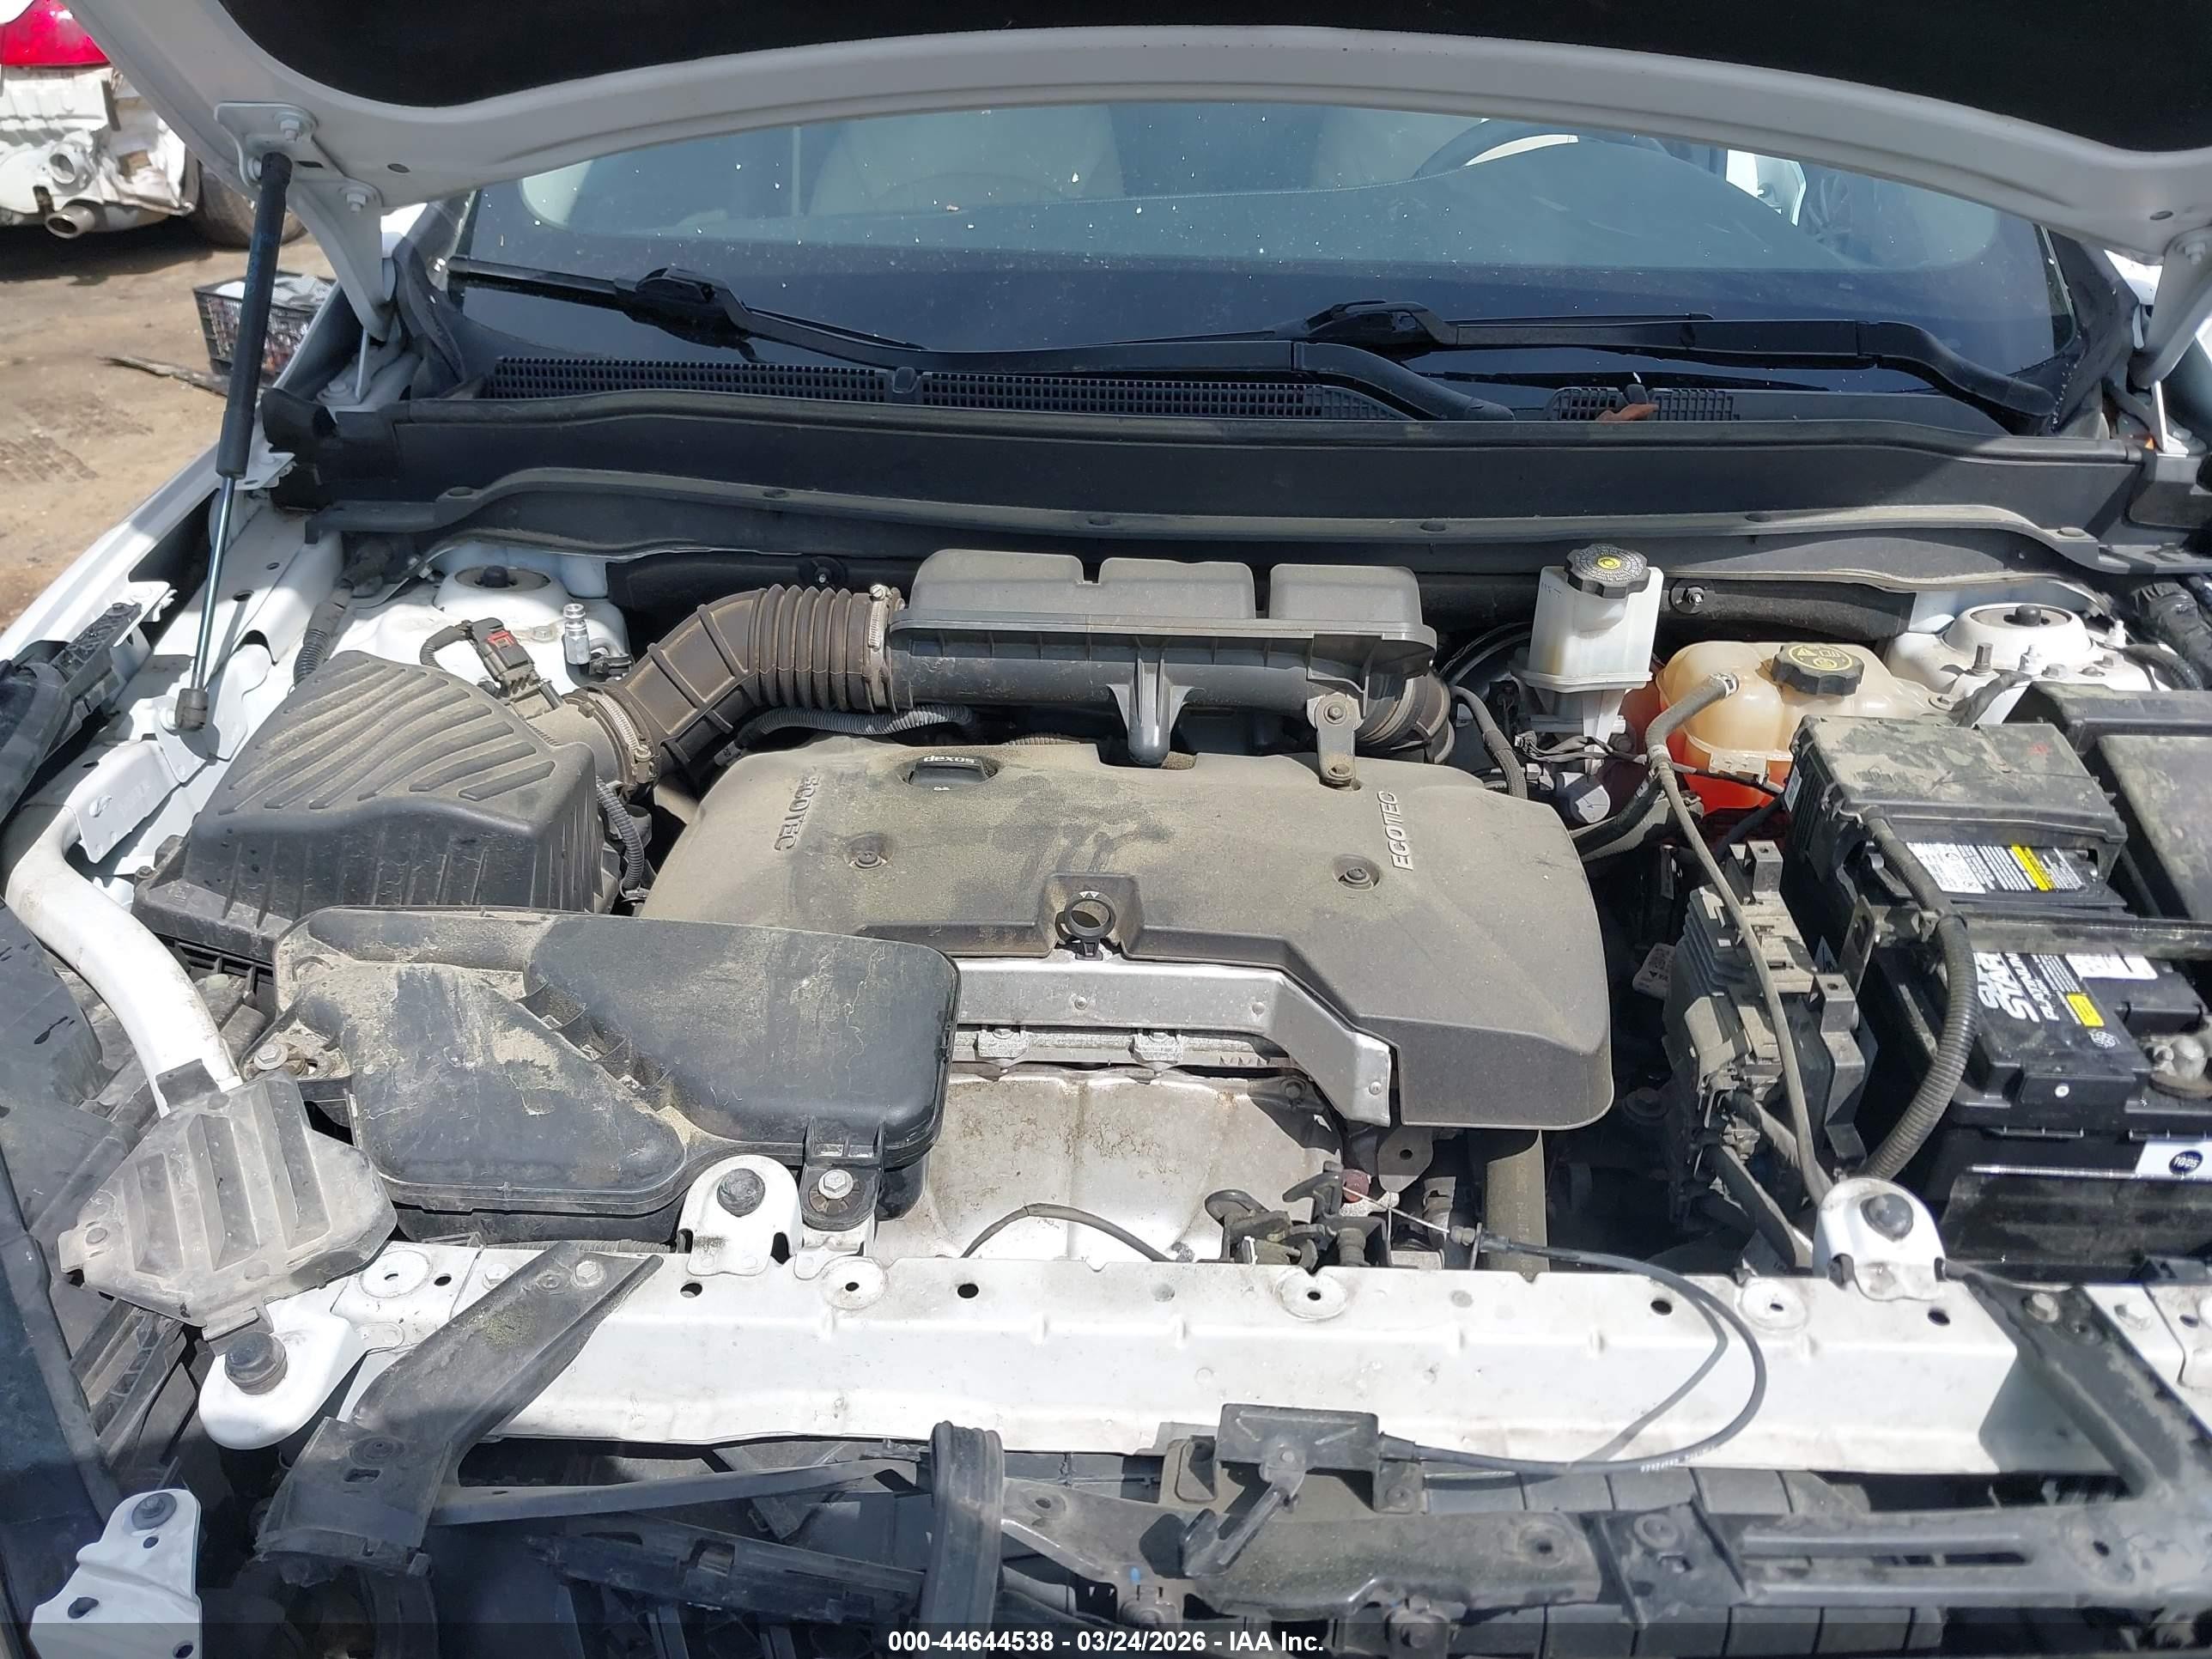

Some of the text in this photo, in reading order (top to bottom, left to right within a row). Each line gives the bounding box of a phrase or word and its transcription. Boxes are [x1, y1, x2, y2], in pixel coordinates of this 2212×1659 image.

[923, 756, 975, 764] dexos
[774, 775, 821, 850] ECOTEC
[1377, 791, 1413, 871] ECOTEC
[1977, 952, 2040, 1023] STAR
[2004, 952, 2060, 1021] PLATINUM
